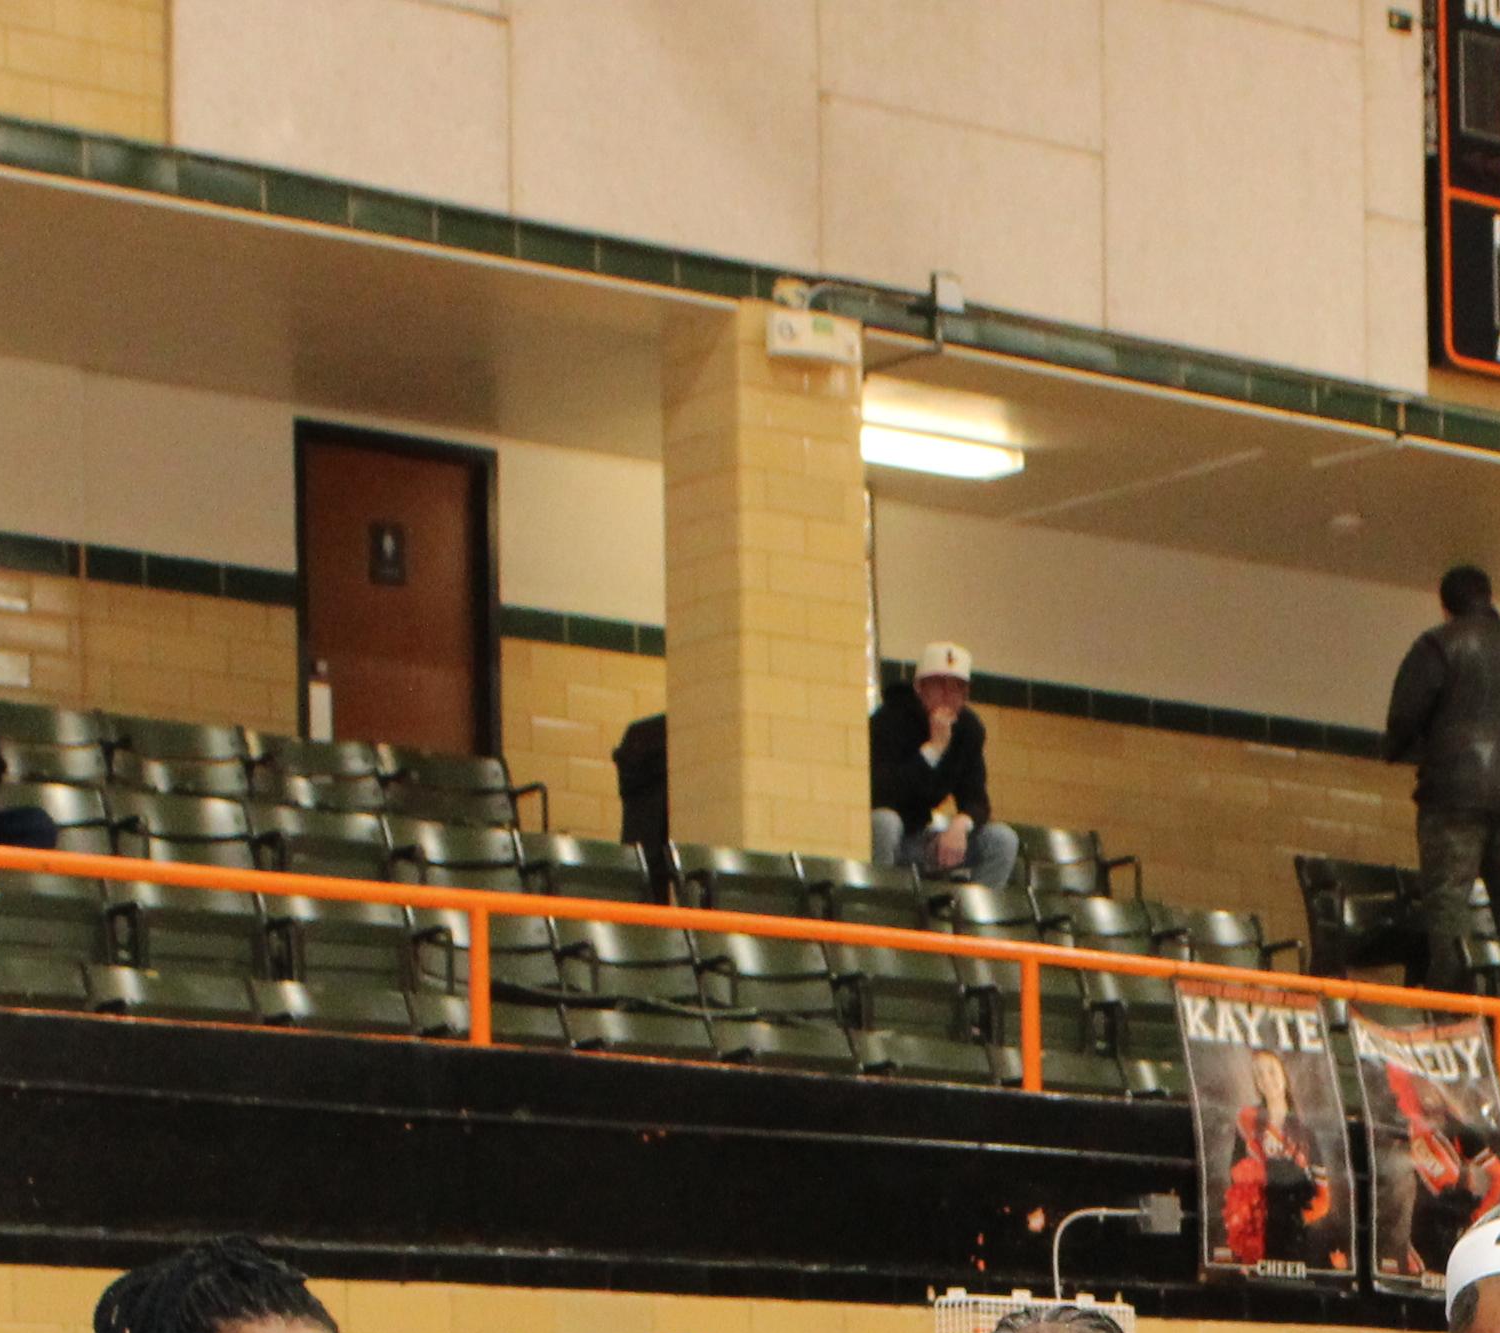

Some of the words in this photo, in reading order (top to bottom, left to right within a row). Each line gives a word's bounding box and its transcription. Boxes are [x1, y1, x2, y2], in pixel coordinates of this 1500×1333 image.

[1179, 995, 1325, 1054] KAYTE
[1351, 1020, 1483, 1084] KNEDY
[1256, 1259, 1307, 1280] CHEER
